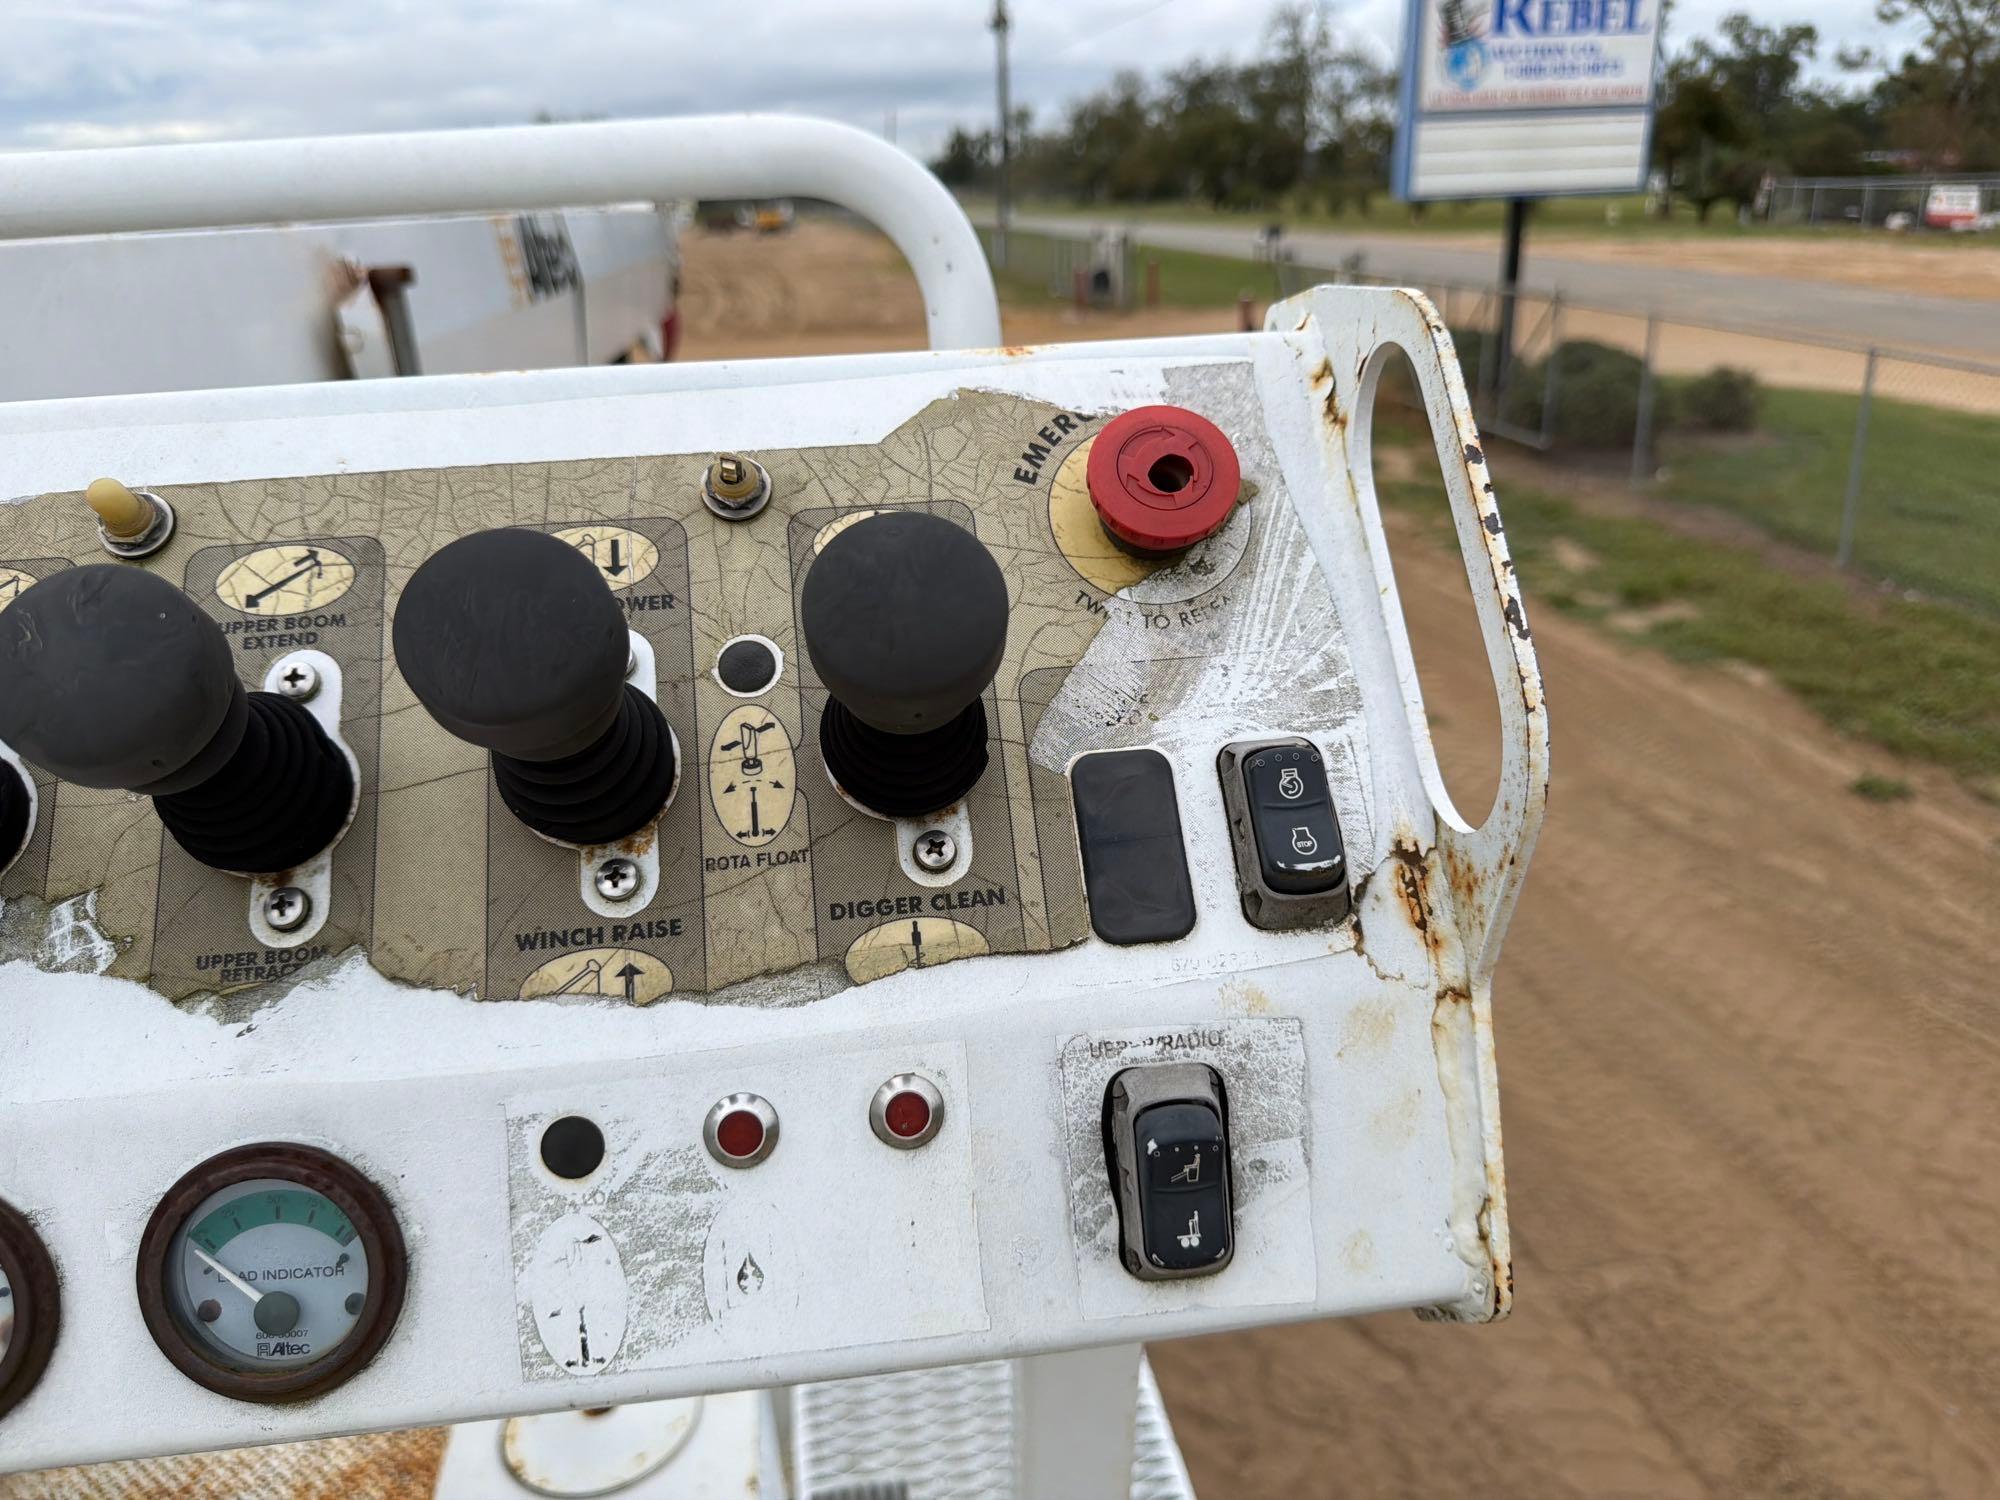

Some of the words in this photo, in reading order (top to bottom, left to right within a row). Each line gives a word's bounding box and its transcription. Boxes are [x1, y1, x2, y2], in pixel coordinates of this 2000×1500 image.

[1013, 412, 1097, 486] EMER
[284, 613, 347, 631] BOOM
[1142, 613, 1171, 629] TO
[242, 632, 320, 650] EXTEND
[1296, 840, 1313, 849] STOP
[705, 854, 751, 872] ROTA
[756, 848, 809, 868] FLOAT
[829, 895, 923, 921] DIGGER
[930, 888, 1007, 912] CLEAN
[515, 926, 605, 951] WINCH
[612, 918, 683, 943] RAISE
[196, 951, 258, 971] UPPER
[217, 1270, 258, 1283] LAD
[263, 1266, 345, 1281] INDICATOR
[270, 1341, 311, 1356] Altec
